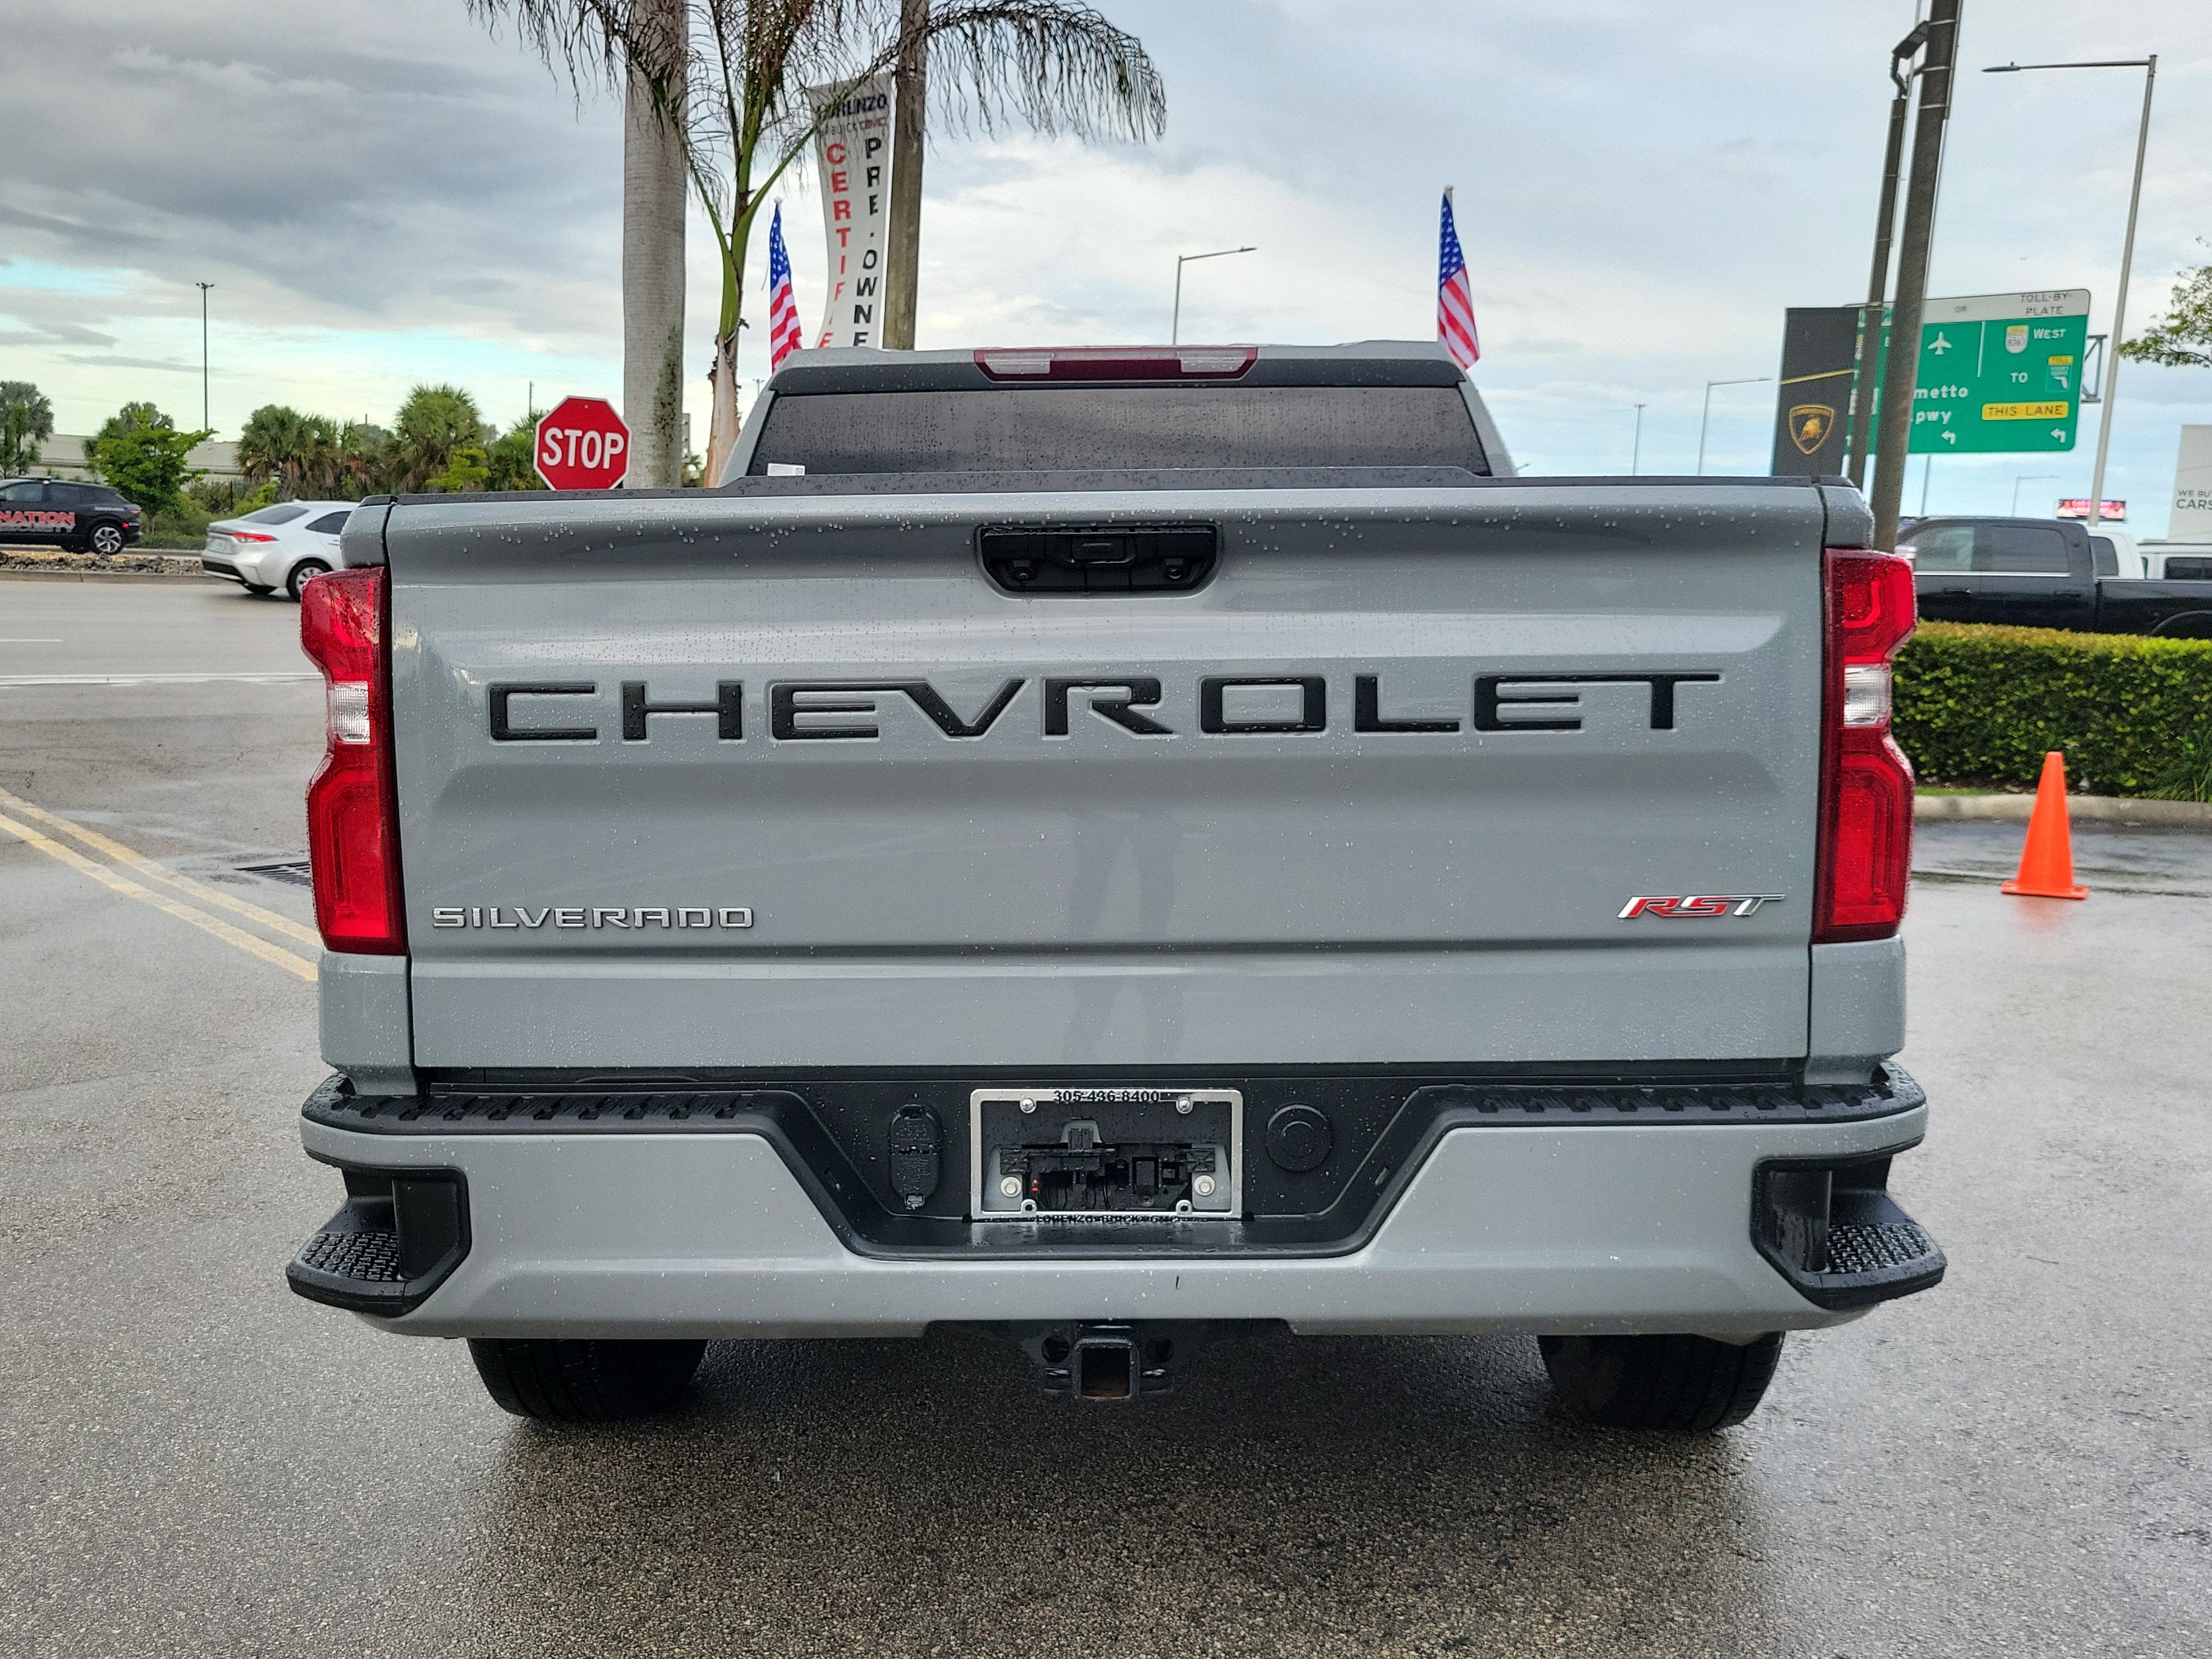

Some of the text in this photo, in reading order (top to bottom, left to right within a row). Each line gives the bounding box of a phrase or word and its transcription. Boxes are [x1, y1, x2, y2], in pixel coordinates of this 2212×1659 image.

[2025, 306, 2063, 315] PLATE
[2033, 328, 2067, 340] WEST
[2010, 371, 2029, 383] TO
[1988, 405, 2063, 416] THIS LANE
[1910, 411, 1953, 425] pwy
[541, 427, 624, 469] STOP
[2176, 499, 2212, 510] CARS
[489, 674, 1720, 740] CHEVROLET
[1617, 894, 1786, 919] RST
[433, 907, 754, 928] SILVERADO
[1053, 1090, 1160, 1103] 305-436-8400
